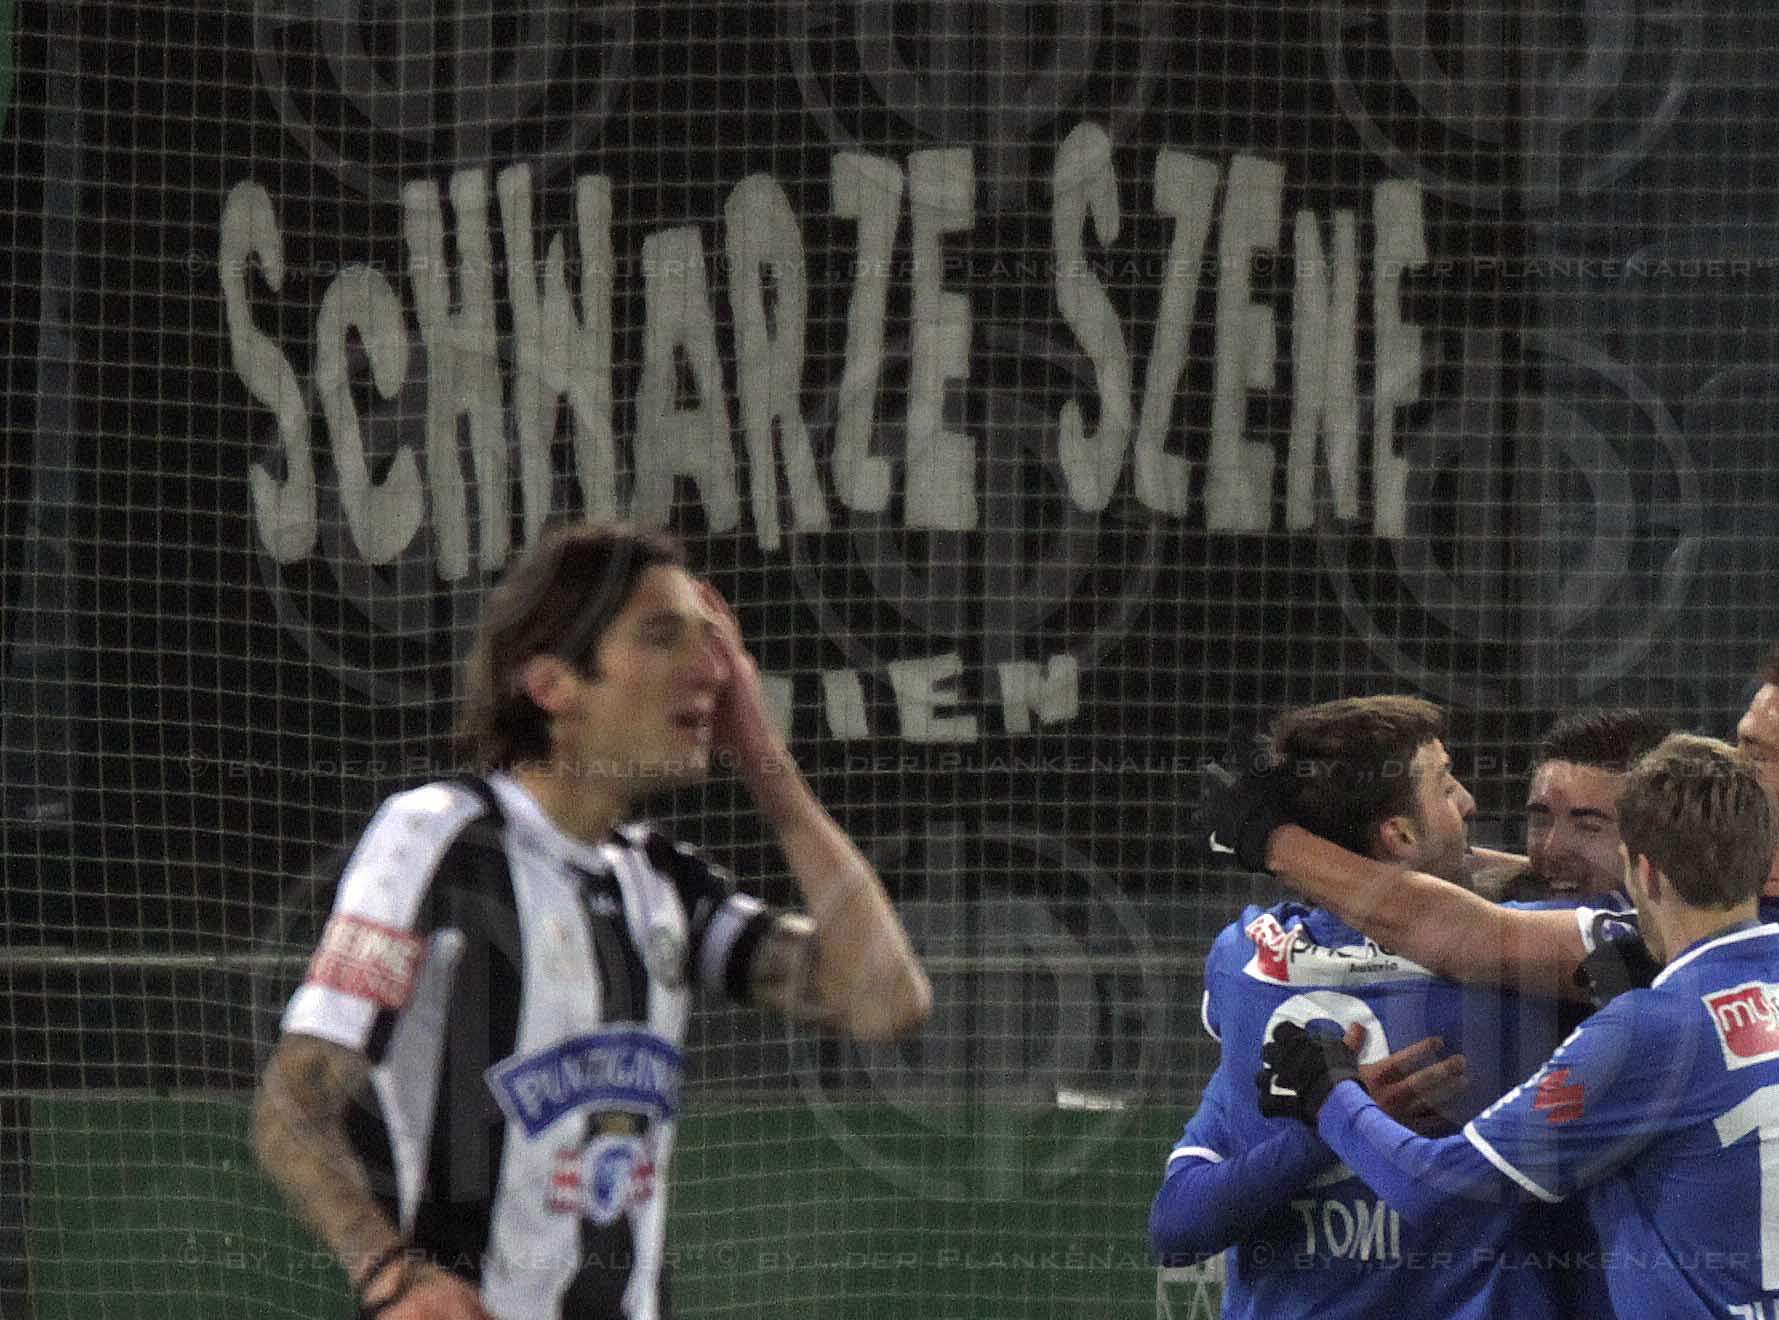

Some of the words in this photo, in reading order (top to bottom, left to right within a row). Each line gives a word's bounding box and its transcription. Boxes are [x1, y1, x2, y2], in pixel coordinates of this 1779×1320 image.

[219, 148, 977, 580] SCHWARZE
[1053, 122, 1426, 540] SZENE
[1291, 1199, 1400, 1261] TOMI
